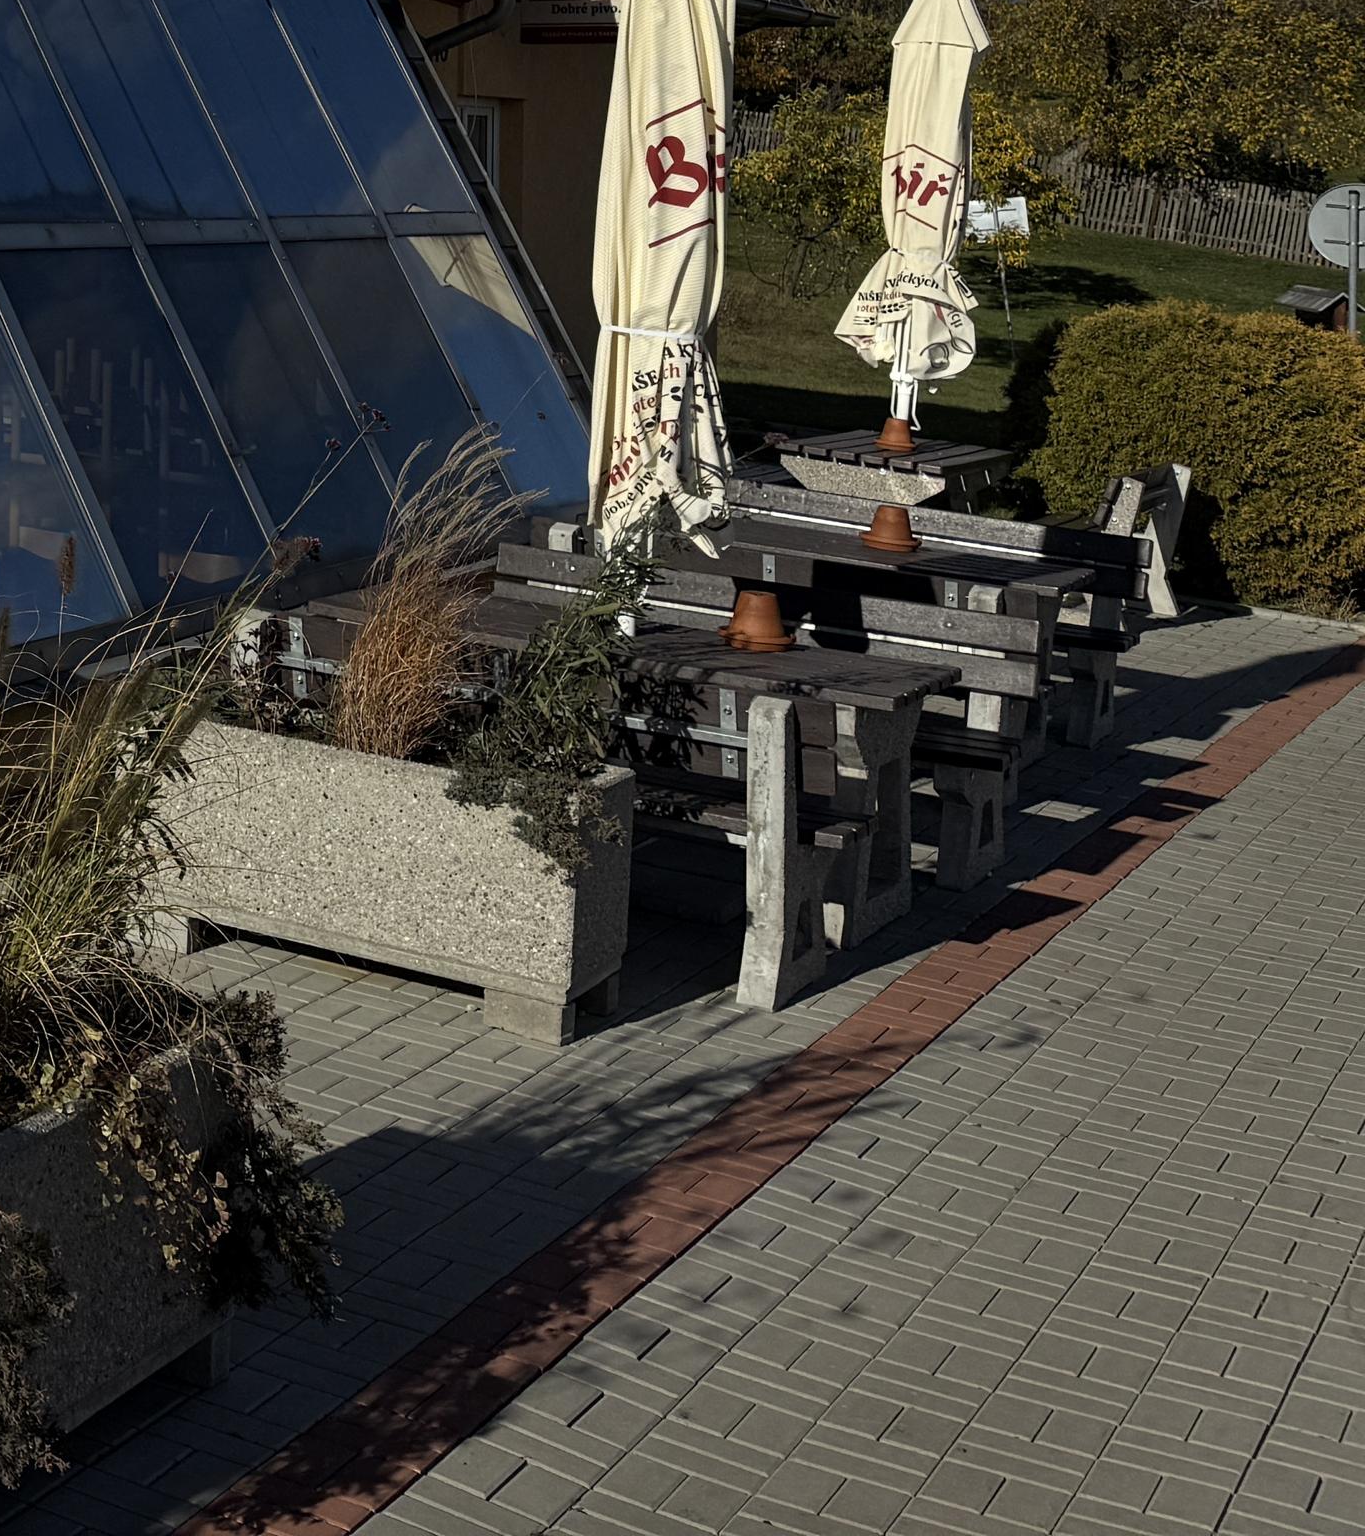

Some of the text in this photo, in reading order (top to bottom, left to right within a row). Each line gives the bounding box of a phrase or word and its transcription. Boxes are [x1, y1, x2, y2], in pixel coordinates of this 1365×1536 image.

[551, 2, 622, 17] Dobré pivo.
[635, 469, 658, 494] piv
